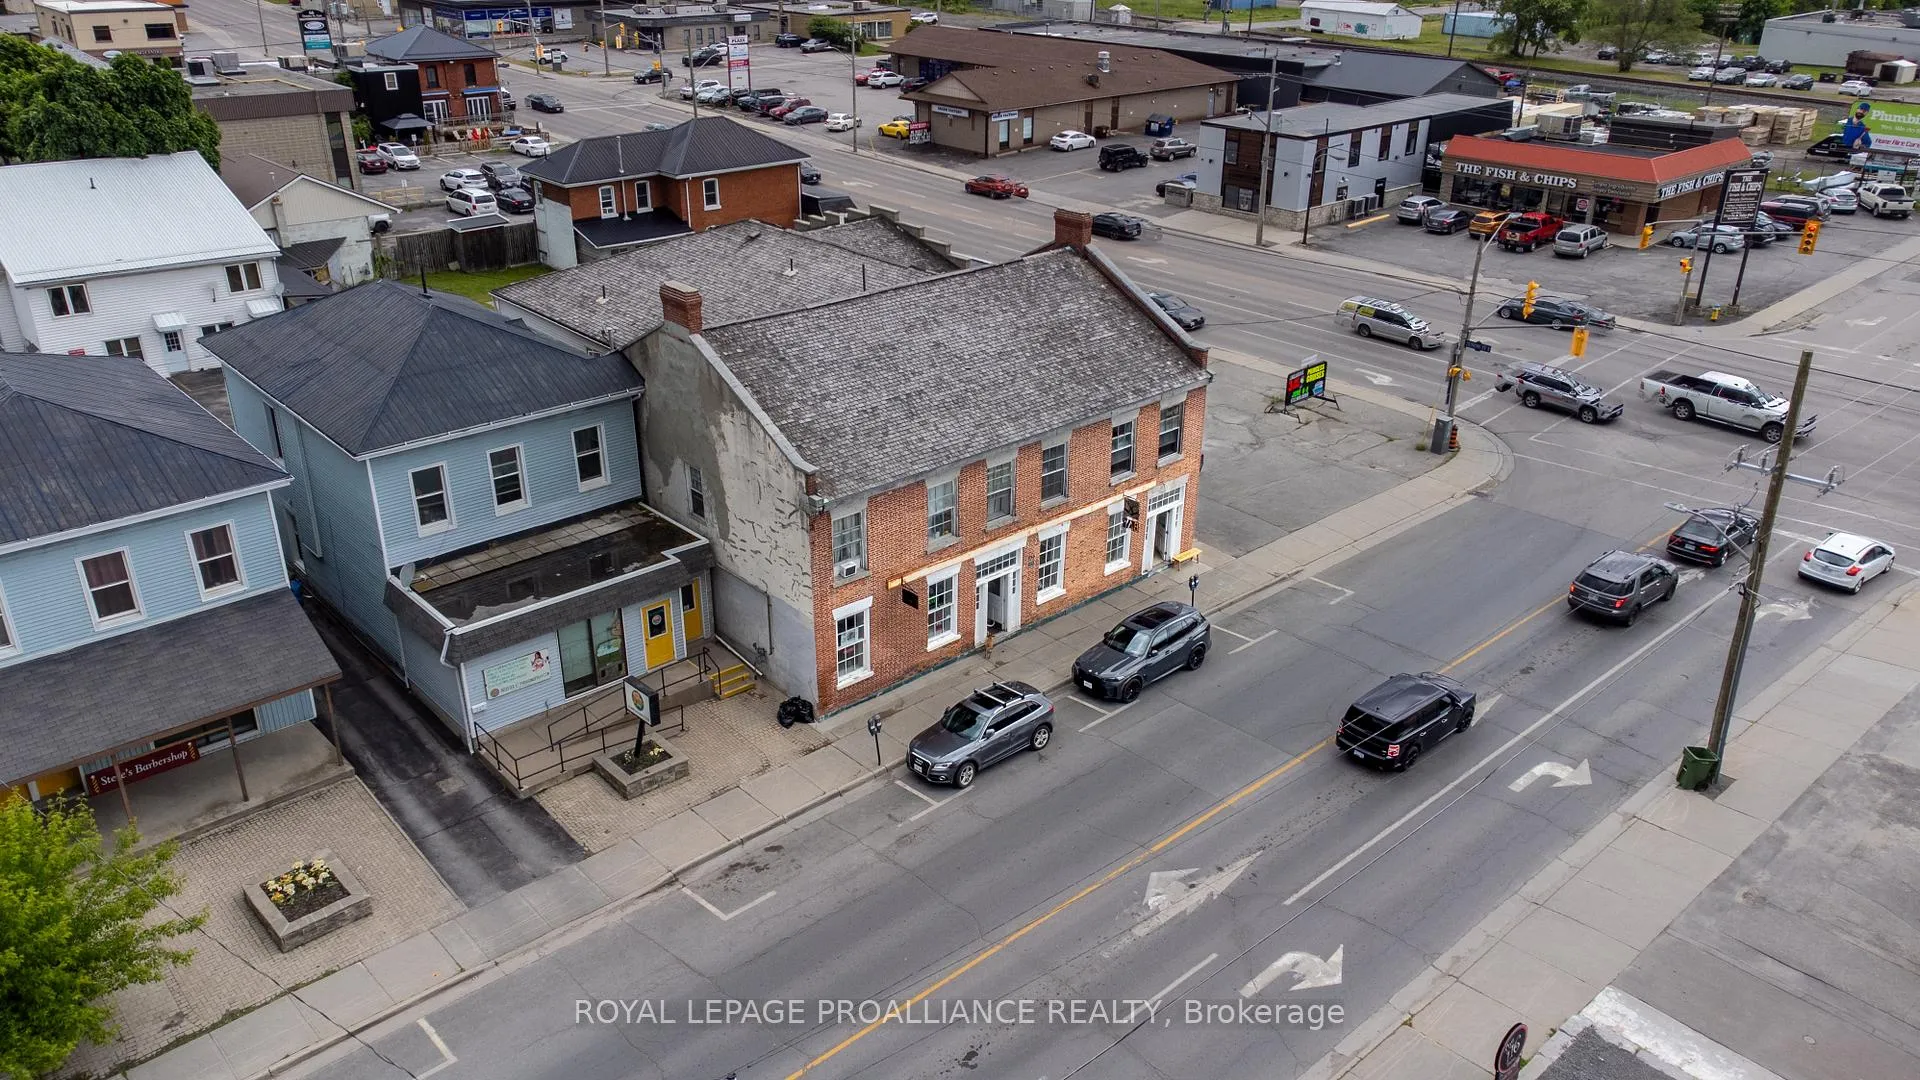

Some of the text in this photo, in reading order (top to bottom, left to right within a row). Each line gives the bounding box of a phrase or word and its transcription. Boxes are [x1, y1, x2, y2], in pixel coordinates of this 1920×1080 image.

[1455, 162, 1577, 189] THE FISH & CHIPS
[1660, 171, 1725, 199] THE FISH & CHIPS
[100, 750, 188, 786] Stee's Barbershop
